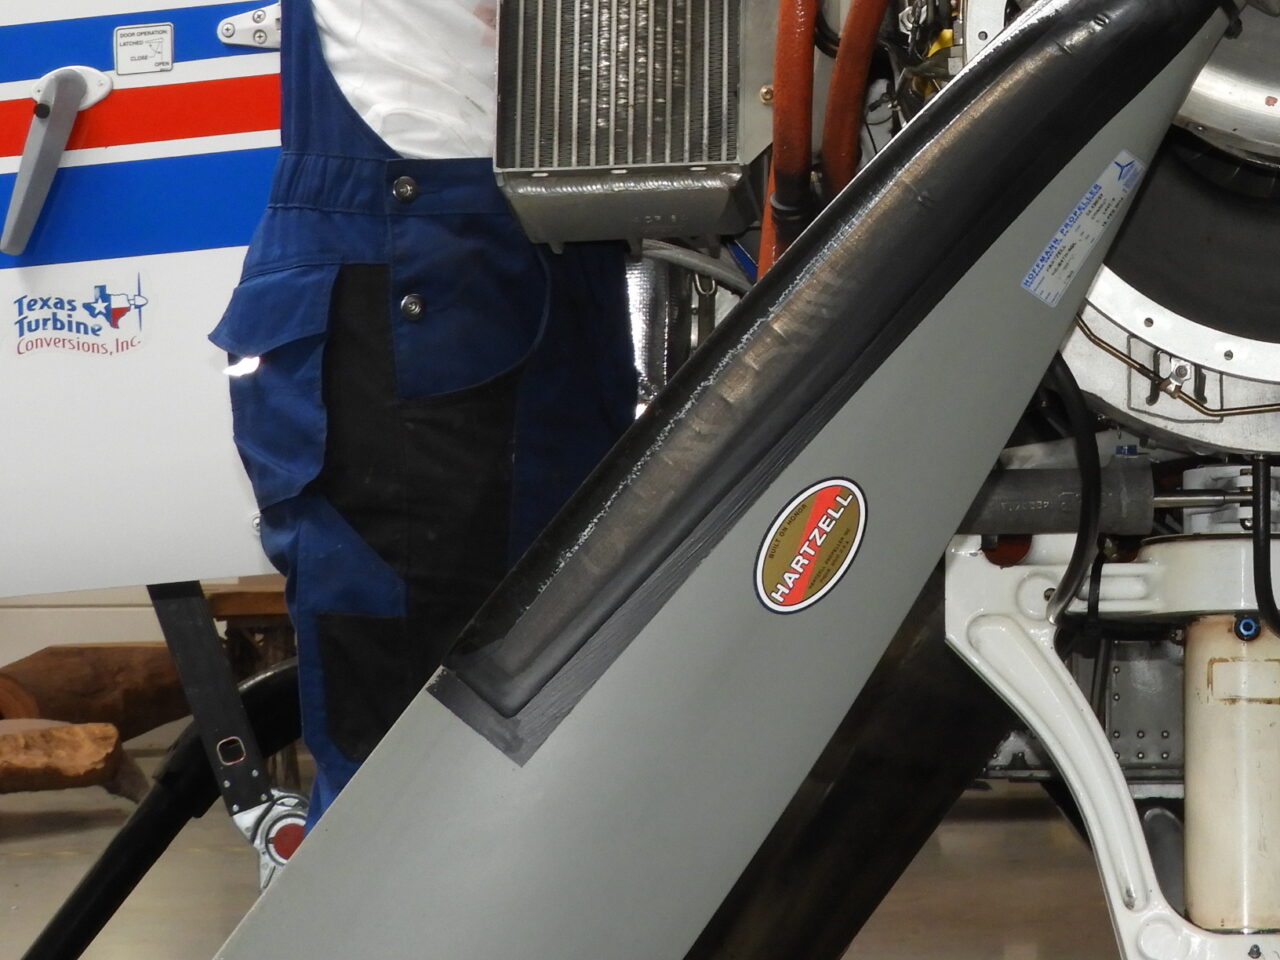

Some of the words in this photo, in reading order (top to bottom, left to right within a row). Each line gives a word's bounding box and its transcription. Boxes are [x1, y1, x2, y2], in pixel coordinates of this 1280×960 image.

[1023, 237, 1059, 287] HOFFMANN
[1059, 183, 1103, 235] PROPELLER
[14, 294, 77, 318] Texas
[14, 312, 103, 338] Turbine
[17, 336, 113, 356] Conversions,
[768, 538, 780, 559] BUILT
[779, 525, 789, 538] ON
[787, 503, 807, 526] HONOR
[770, 493, 854, 603] HARTZELL
